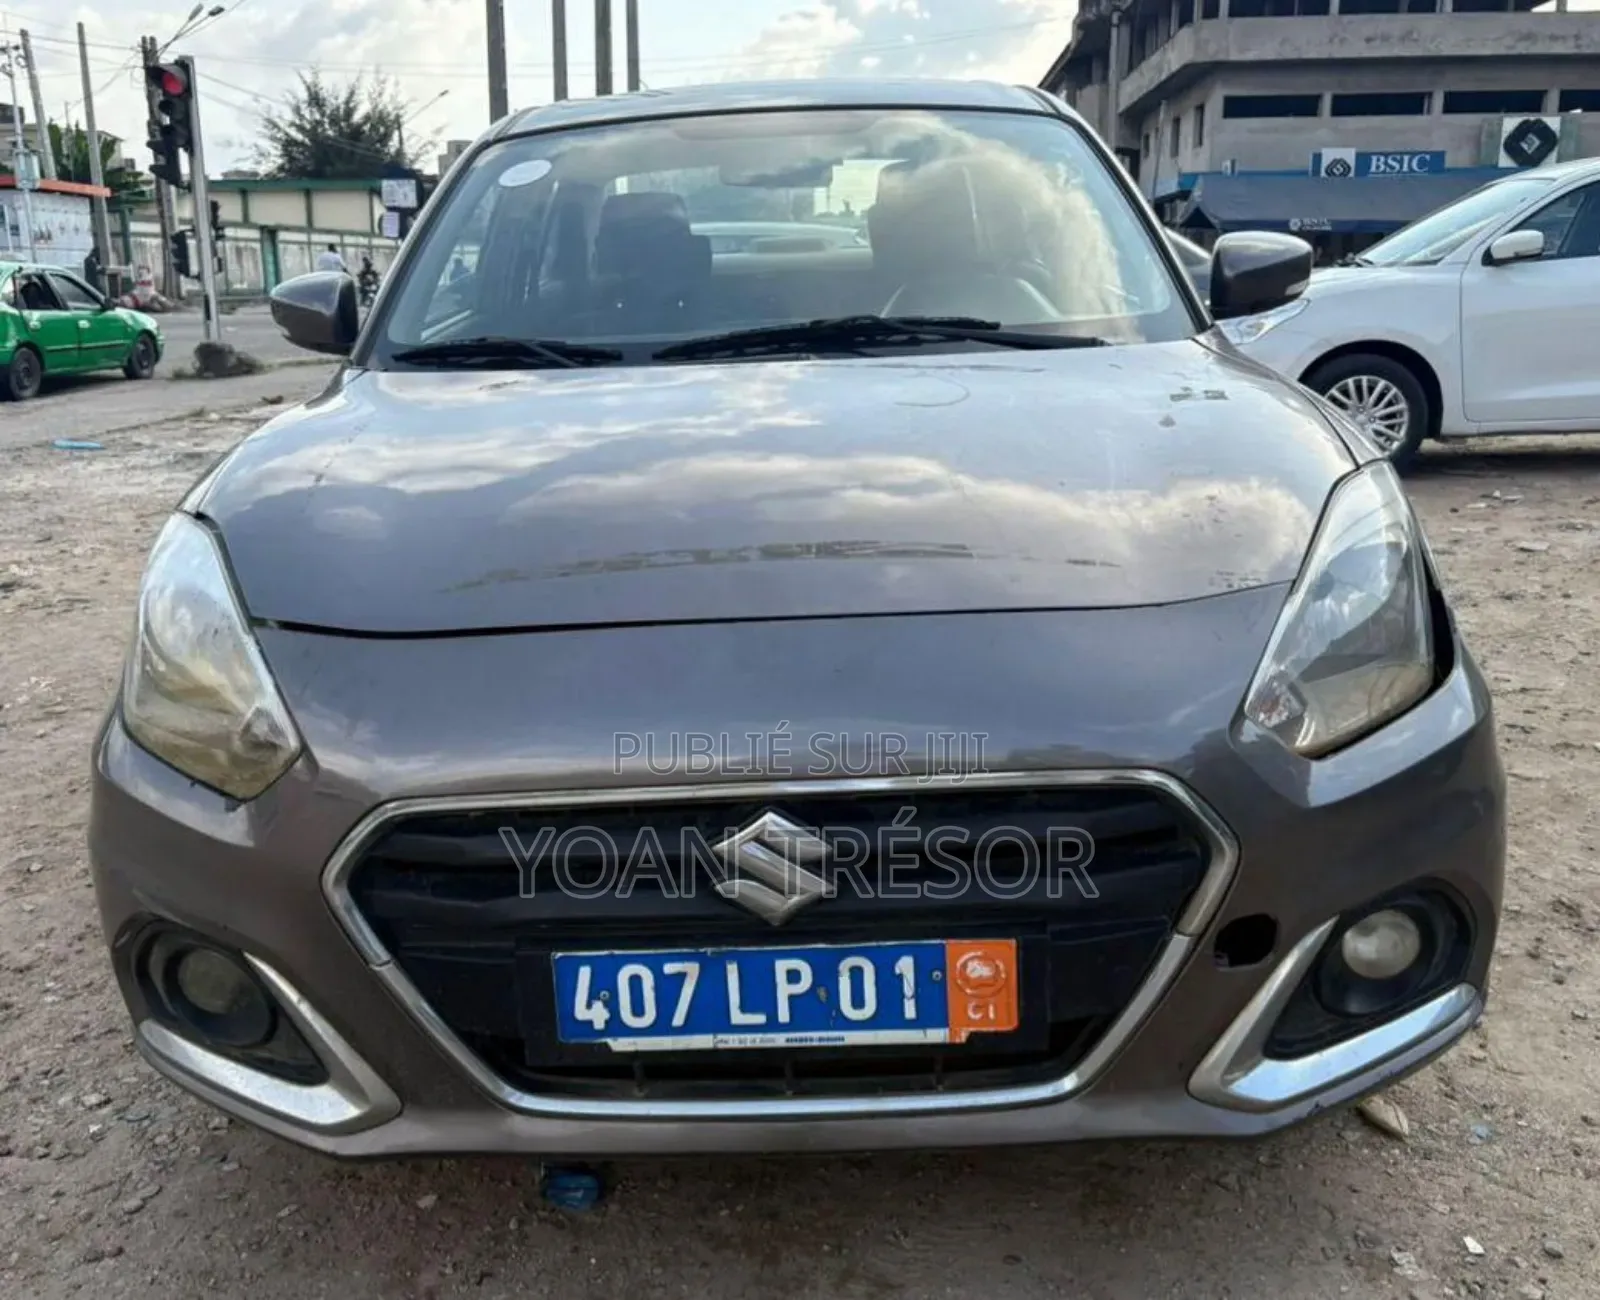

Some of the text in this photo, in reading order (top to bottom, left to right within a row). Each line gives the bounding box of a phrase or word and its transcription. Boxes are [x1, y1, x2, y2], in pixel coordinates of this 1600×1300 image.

[1369, 153, 1431, 173] BSIC
[572, 955, 916, 1030] 407 LP 01
